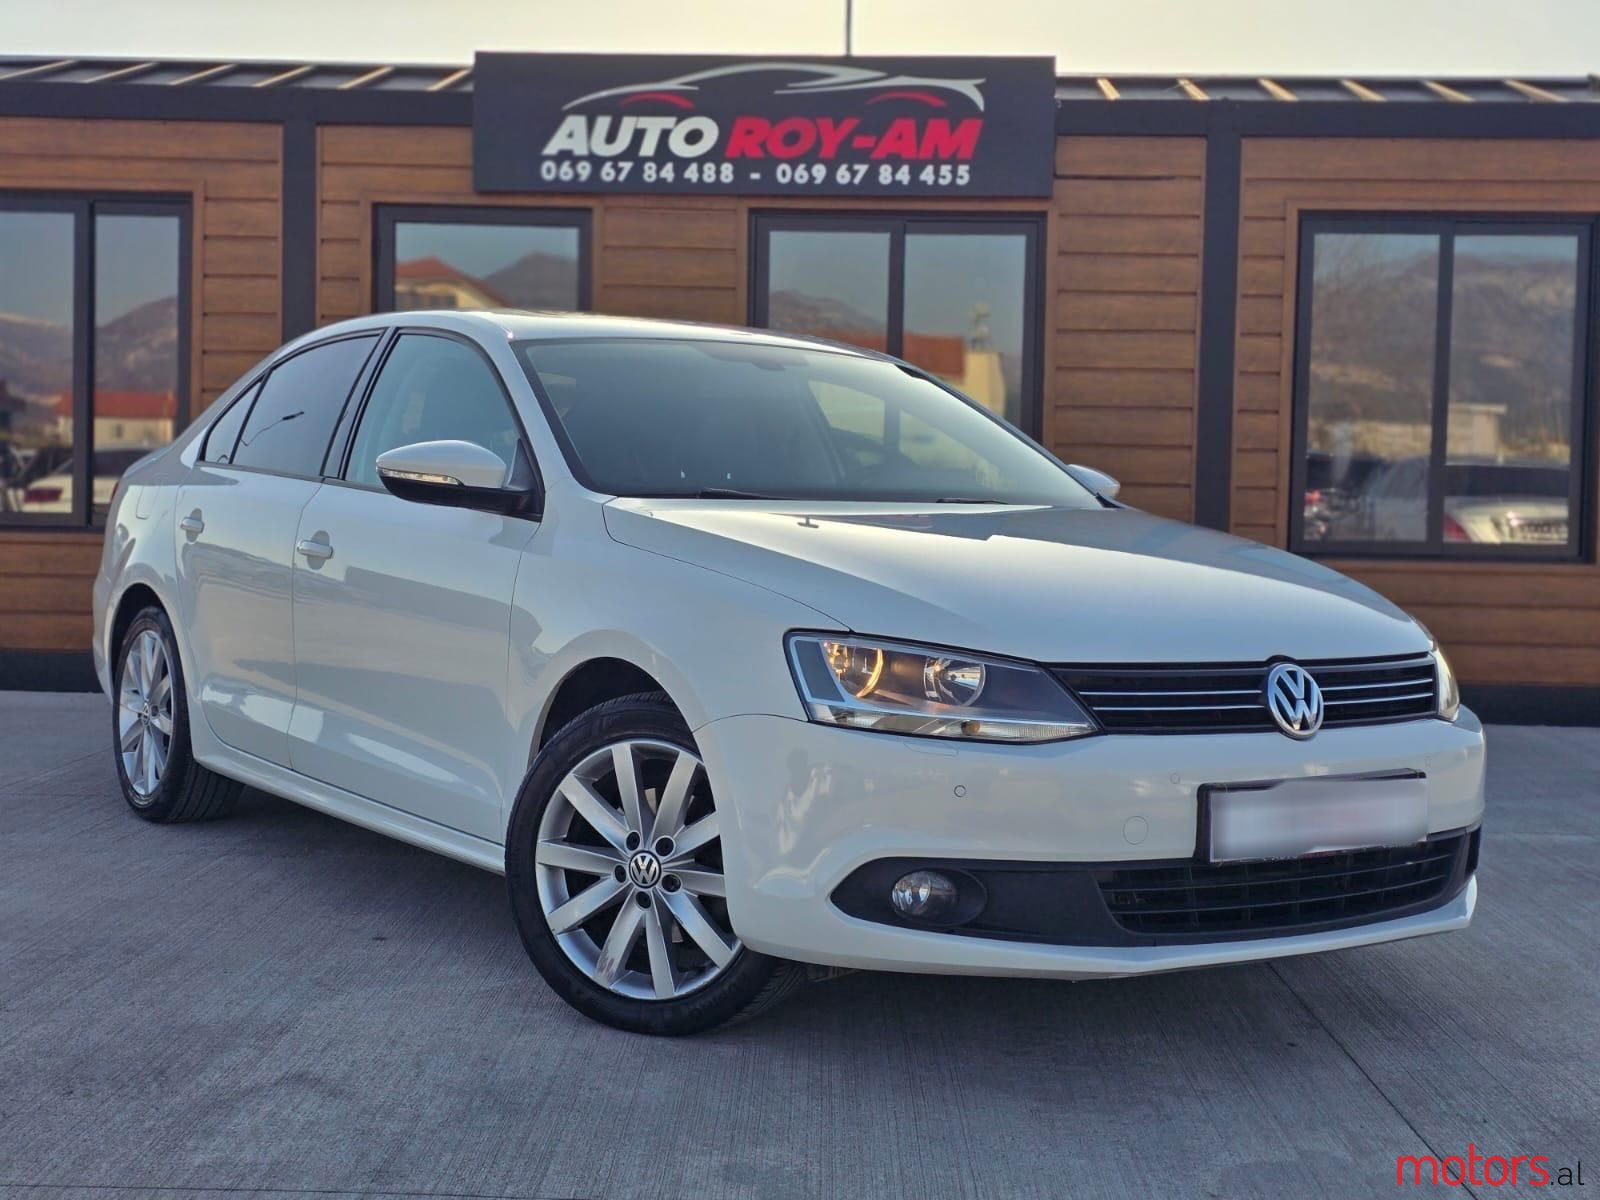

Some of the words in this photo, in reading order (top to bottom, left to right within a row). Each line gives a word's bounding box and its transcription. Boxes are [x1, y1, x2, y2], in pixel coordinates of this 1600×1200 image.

[541, 115, 719, 158] AUTO
[724, 116, 983, 160] ROY-AM
[541, 160, 592, 182] 069
[600, 161, 634, 182] 67
[642, 162, 675, 183] 84
[683, 162, 734, 183] 488
[776, 163, 827, 184] 069
[835, 164, 869, 184] 67
[878, 164, 911, 185] 84
[919, 164, 970, 185] 455
